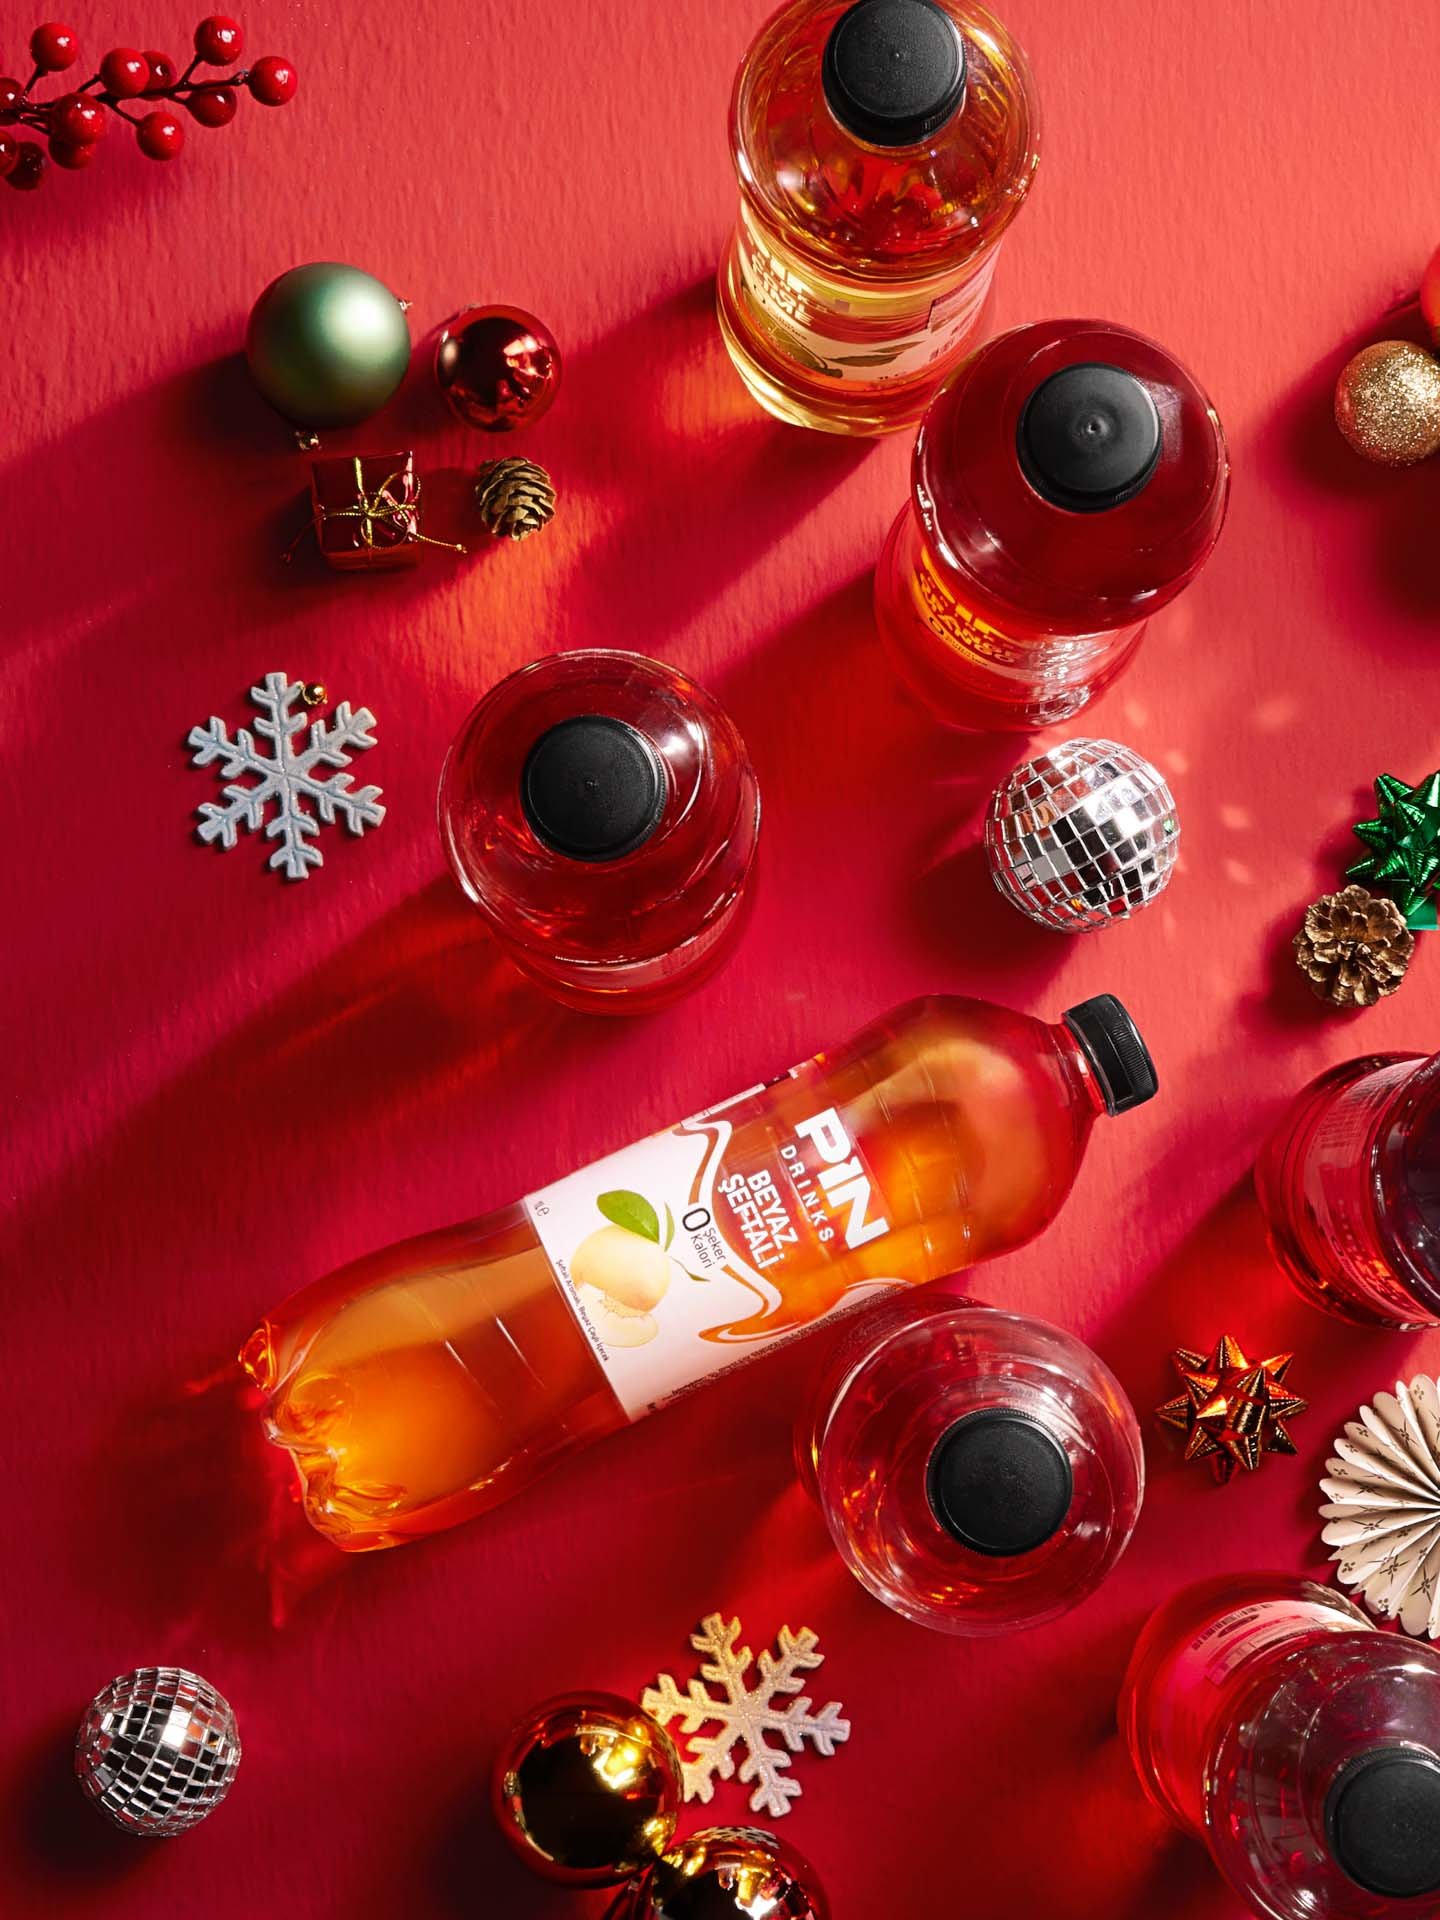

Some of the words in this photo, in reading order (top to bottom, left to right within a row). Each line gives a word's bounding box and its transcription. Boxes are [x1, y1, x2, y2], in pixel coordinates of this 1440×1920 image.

[718, 1173, 785, 1269] ŞEFTALİ
[747, 1169, 799, 1250] BEYAZ
[781, 1145, 834, 1243] DRINKS
[795, 1107, 890, 1250] PIN
[682, 1208, 711, 1232] 0
[703, 1227, 726, 1261] Şeker
[690, 1234, 715, 1269] Kalori
